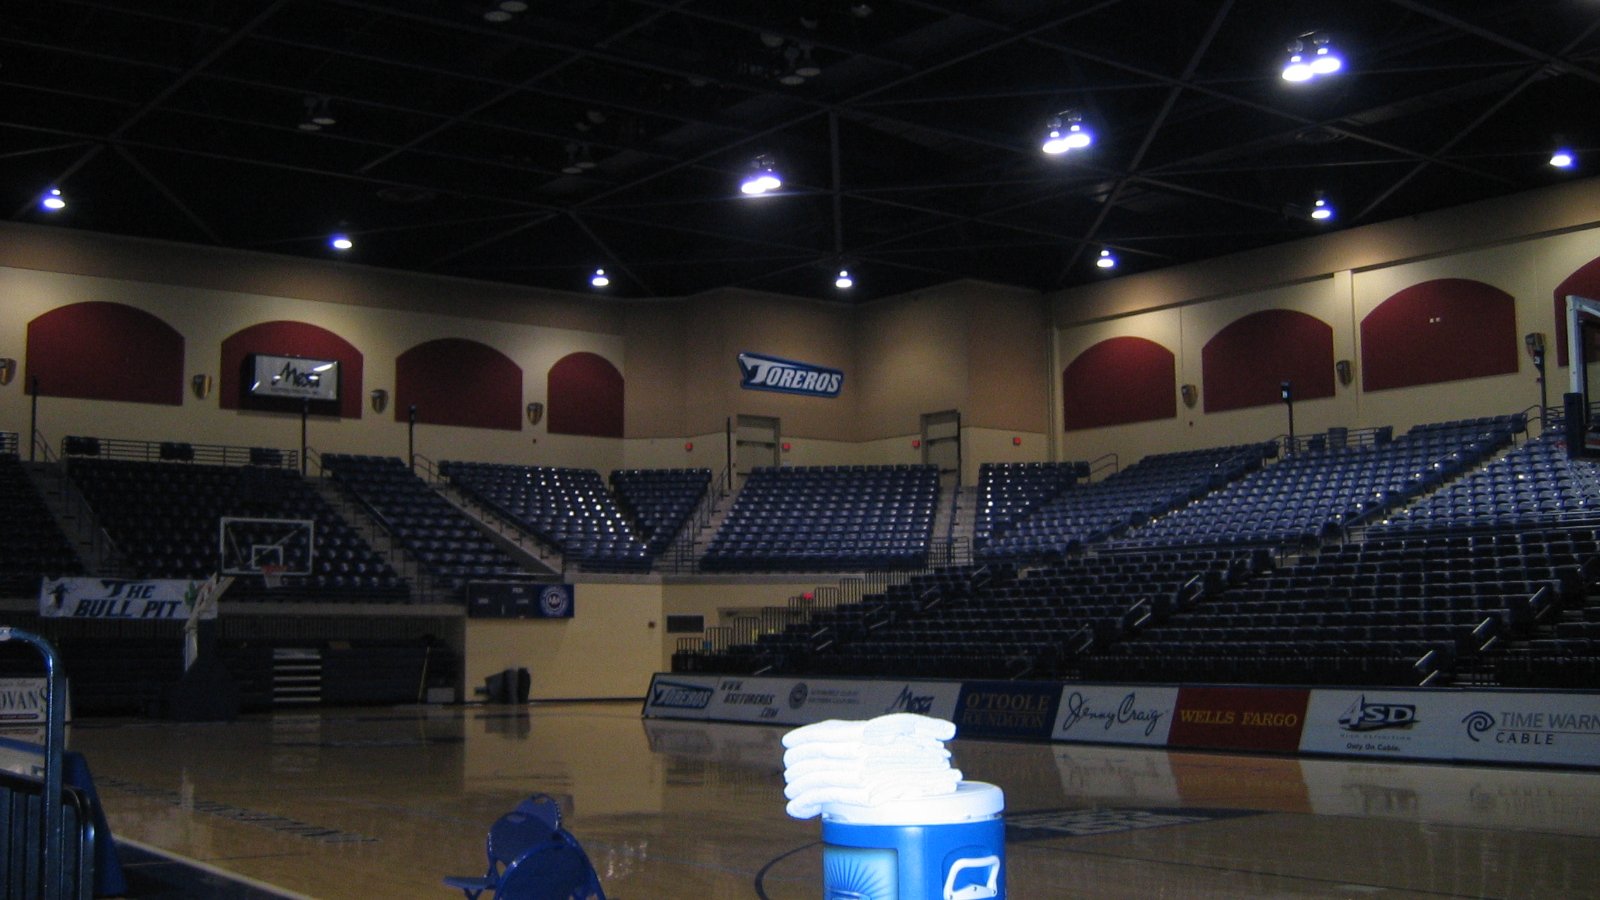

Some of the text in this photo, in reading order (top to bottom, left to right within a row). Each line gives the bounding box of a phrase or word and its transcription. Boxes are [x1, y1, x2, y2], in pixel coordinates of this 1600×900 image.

[739, 354, 842, 393] TOREROS
[99, 580, 155, 598] THE
[73, 599, 183, 618] BULL PIT
[885, 683, 936, 713] Mesa
[966, 692, 1052, 711] O'TOOLE
[1062, 691, 1165, 736] Jenny Craig
[1181, 709, 1298, 727] WELLS FARGO
[1501, 712, 1600, 729] TIME WARN
[1495, 732, 1554, 745] CABLE
